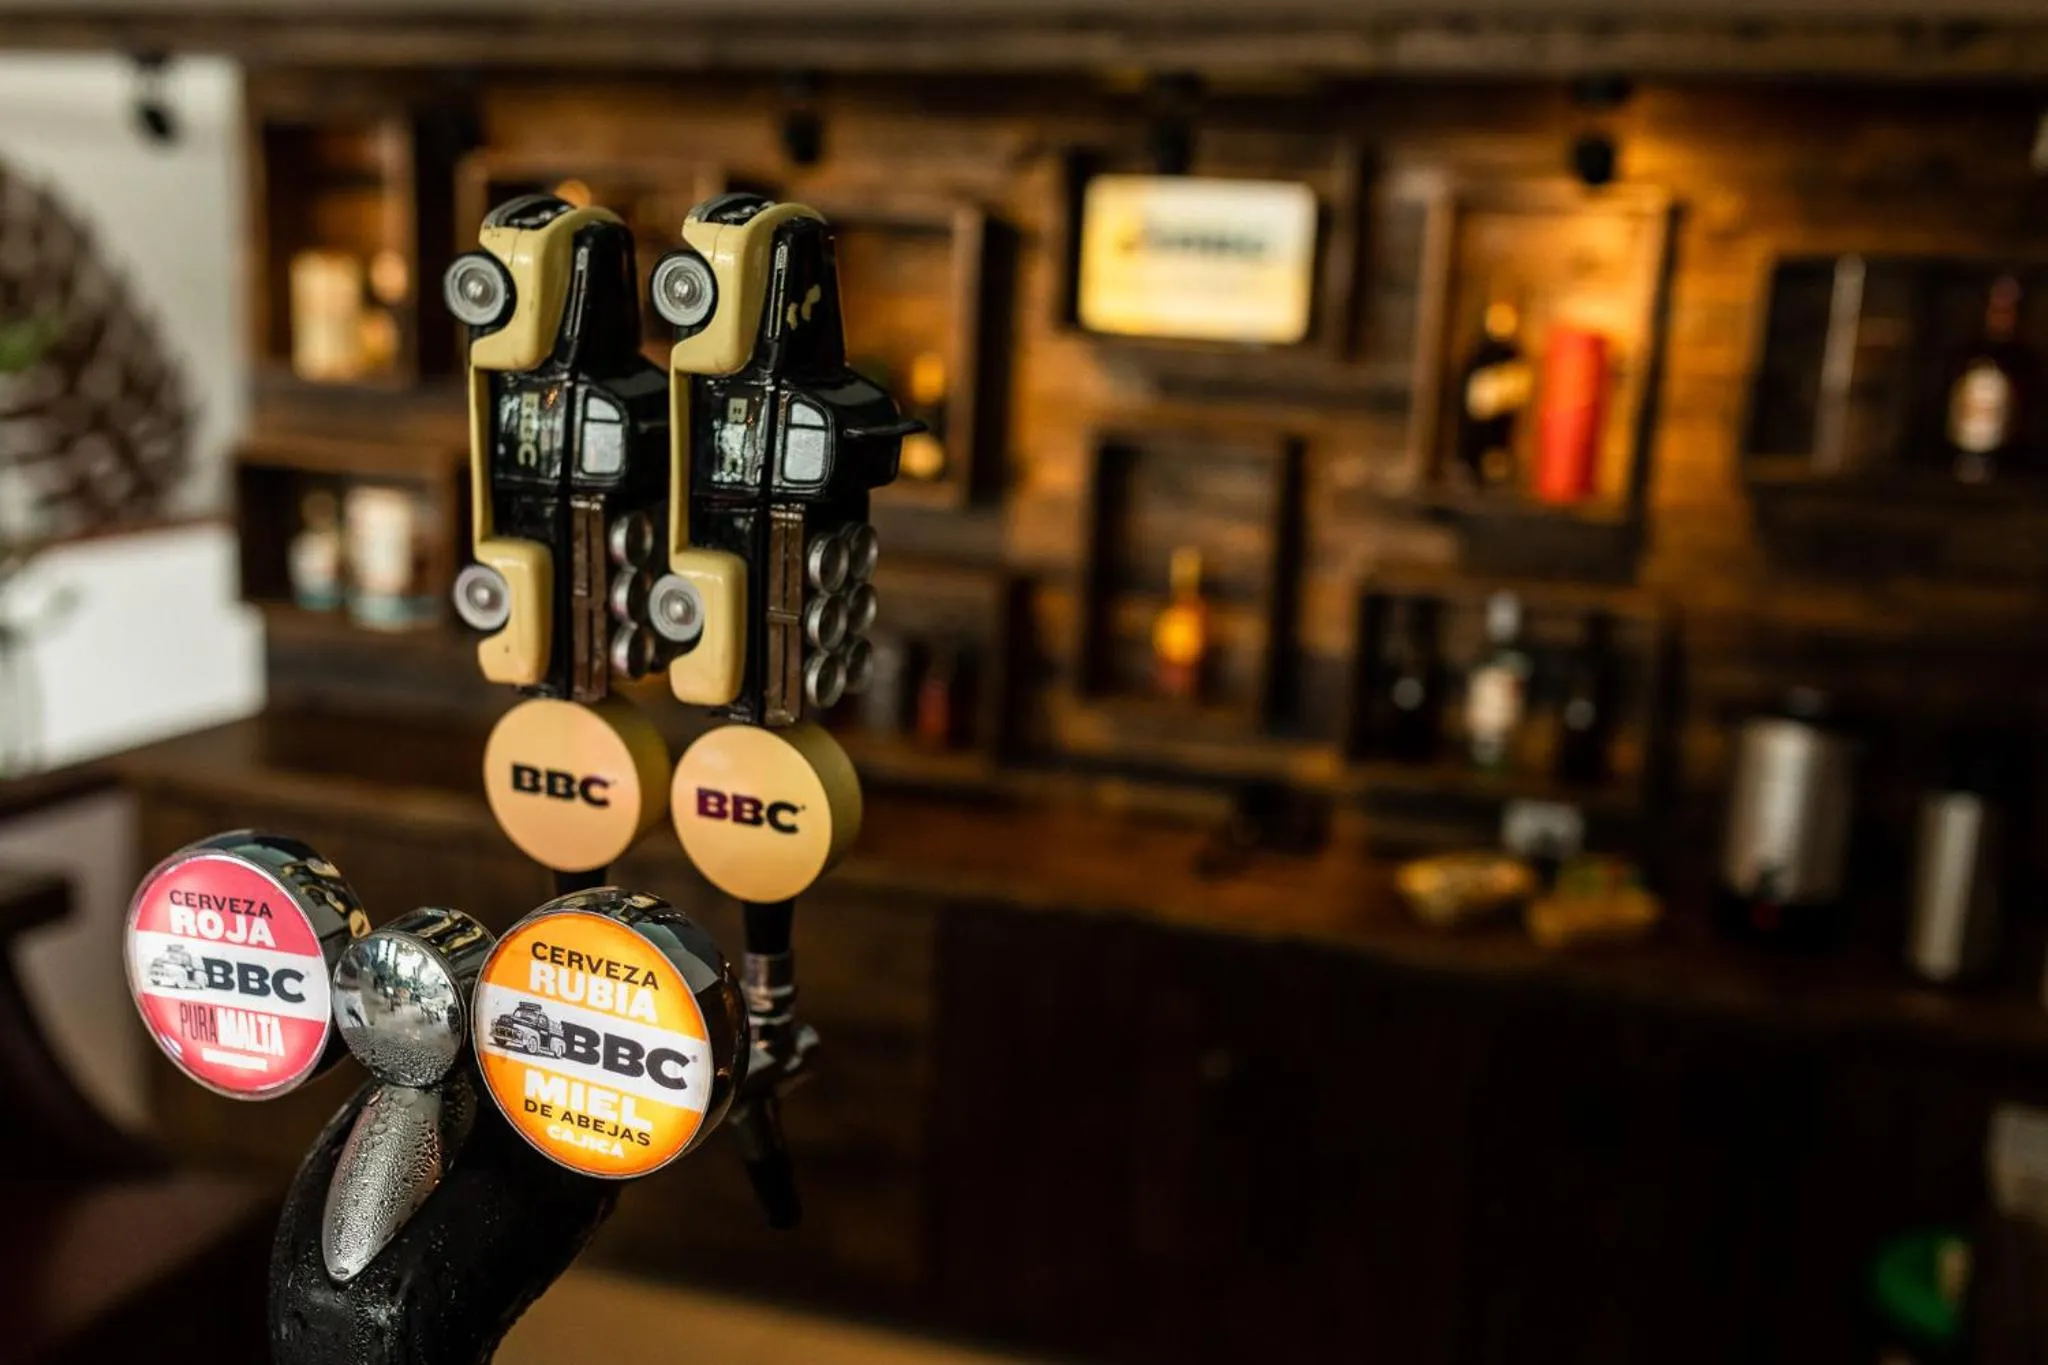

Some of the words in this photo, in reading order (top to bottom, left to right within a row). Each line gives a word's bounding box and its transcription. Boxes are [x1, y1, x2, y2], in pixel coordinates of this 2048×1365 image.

[511, 762, 612, 809] BBC
[696, 787, 800, 835] BBC
[169, 889, 273, 919] CERVEZA
[169, 905, 277, 949] ROJA
[201, 956, 307, 1004] BBC
[531, 941, 660, 991] CERVEZA
[528, 960, 659, 1024] RUBIA
[179, 1002, 219, 1045] PURA
[216, 1006, 286, 1058] MALTA
[560, 1020, 691, 1091] BBC
[524, 1069, 653, 1132] MIEL
[524, 1098, 553, 1119] DE
[560, 1110, 651, 1147] ABEJAS
